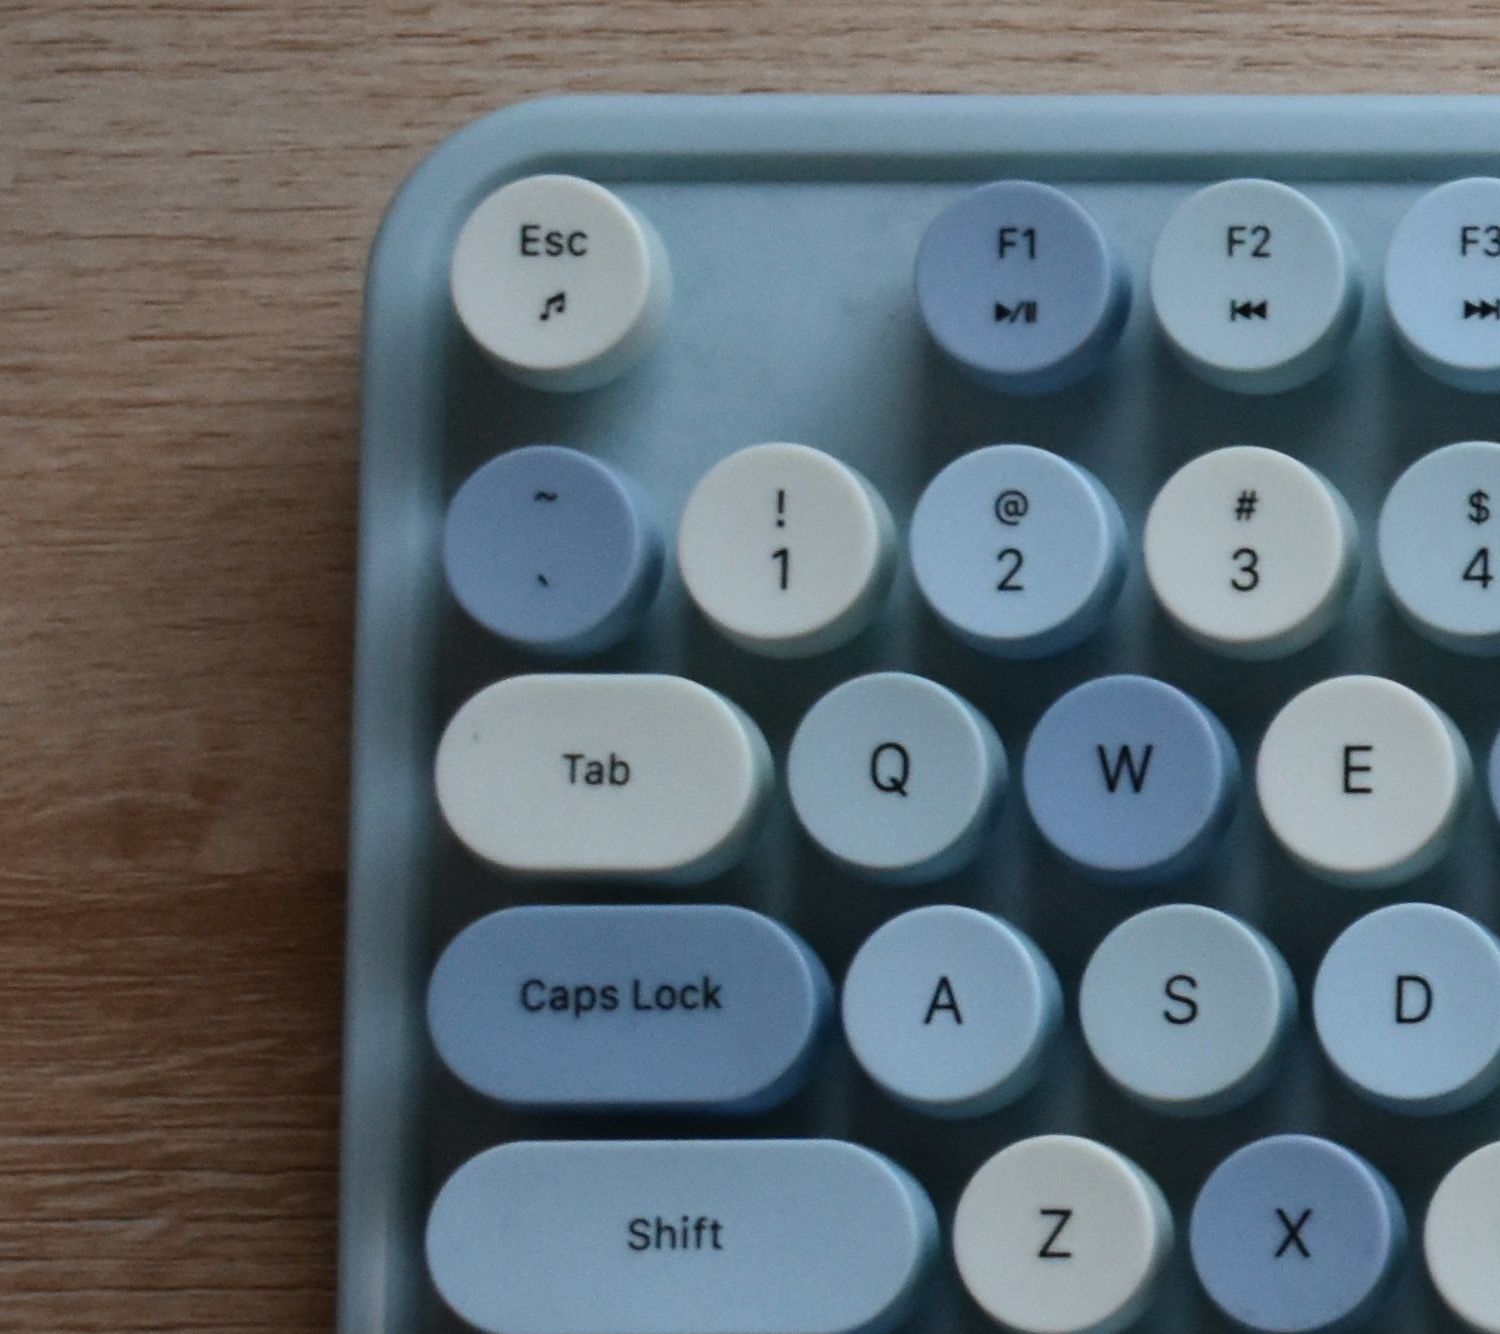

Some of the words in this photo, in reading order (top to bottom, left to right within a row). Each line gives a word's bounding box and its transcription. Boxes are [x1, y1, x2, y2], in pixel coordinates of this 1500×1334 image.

[520, 224, 587, 257] Esc
[998, 227, 1036, 259] F1
[1227, 225, 1271, 258] F2
[775, 489, 786, 529] !
[994, 490, 1029, 526] @
[1234, 491, 1258, 520] #
[1468, 489, 1490, 525] $
[772, 548, 789, 590] 1
[996, 547, 1024, 592] 2
[1231, 547, 1259, 592] 3
[1462, 547, 1493, 589] 4
[563, 753, 630, 786] Tab
[870, 742, 910, 797] Q
[1096, 744, 1153, 794] W
[1342, 745, 1373, 795] E
[520, 979, 619, 1018] Caps
[632, 976, 721, 1011] Lock
[923, 976, 963, 1025] A
[1163, 974, 1198, 1025] S
[1395, 974, 1433, 1025] D
[628, 1216, 722, 1251] Shift
[1038, 1208, 1072, 1259] Z
[1274, 1208, 1312, 1259] X
